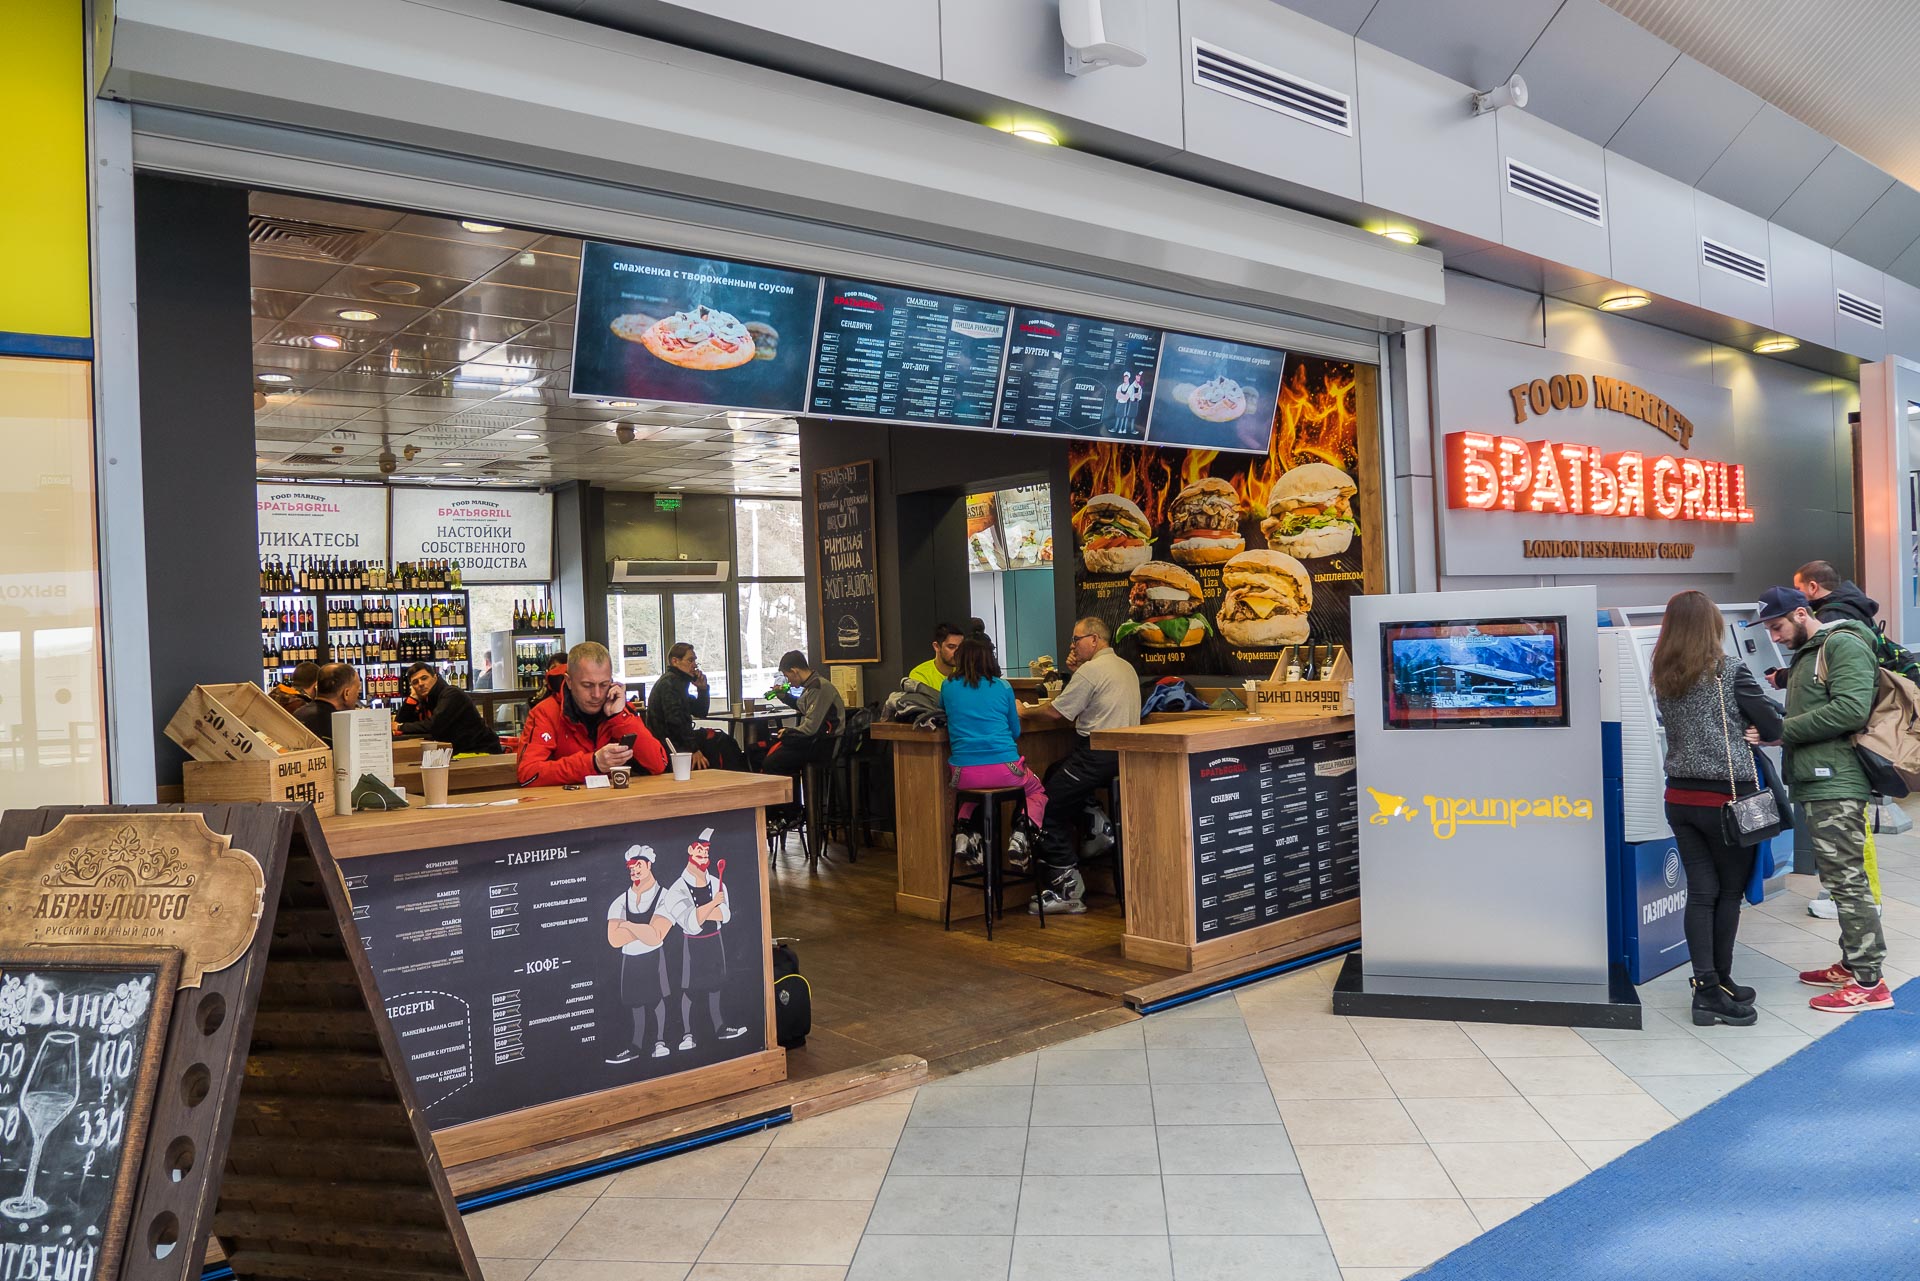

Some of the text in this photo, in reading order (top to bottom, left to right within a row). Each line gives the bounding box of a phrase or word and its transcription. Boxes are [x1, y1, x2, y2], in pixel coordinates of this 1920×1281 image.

[613, 261, 794, 295] смаженка с твороженным соусом
[1024, 346, 1050, 357] БУРГЕРЫ
[1509, 373, 1694, 450] FOOD MARKET
[1446, 431, 1754, 523] БРАТЬЯ GRILL
[271, 493, 326, 502] FOOD MARKET
[472, 500, 499, 508] MARKET
[437, 525, 512, 538] НАСТОЙКИ
[421, 541, 526, 554] СОБСТВЕННОГО
[824, 534, 863, 555] РИМСКАЯ
[1523, 539, 1695, 559] LONDON RESTAURANT GROUP
[830, 551, 863, 572] ПИЦЦА
[1200, 568, 1220, 578] Mona
[1314, 571, 1364, 583] цыпленком
[1203, 578, 1219, 587] Liza
[1203, 588, 1217, 598] 380
[1145, 652, 1166, 665] Lucky
[1167, 652, 1179, 662] 490
[1257, 691, 1291, 703] ВИНО
[203, 708, 225, 730] 50
[231, 732, 253, 754] 50
[278, 756, 327, 778] ВИНО ДНЯ
[508, 847, 568, 866] ГАРНИРЫ
[103, 874, 129, 888] 1870
[550, 877, 576, 887] КАРТОФЕЛЬ
[441, 918, 462, 926] СПАЙСИ
[46, 925, 165, 939] РУССКИЙ ВИННЫЙ ДОМ
[450, 949, 464, 957] АЗИЯ
[526, 957, 560, 975] КОФЕ
[23, 973, 118, 1028] Вино
[402, 1027, 426, 1038] ПАНКЕЙК
[427, 1024, 447, 1033] БАНАНА
[87, 1040, 133, 1079] 100
[411, 1050, 436, 1061] ПАНКЕЙК
[75, 1107, 124, 1147] 330
[0, 1237, 98, 1281] ТВЕЙН
